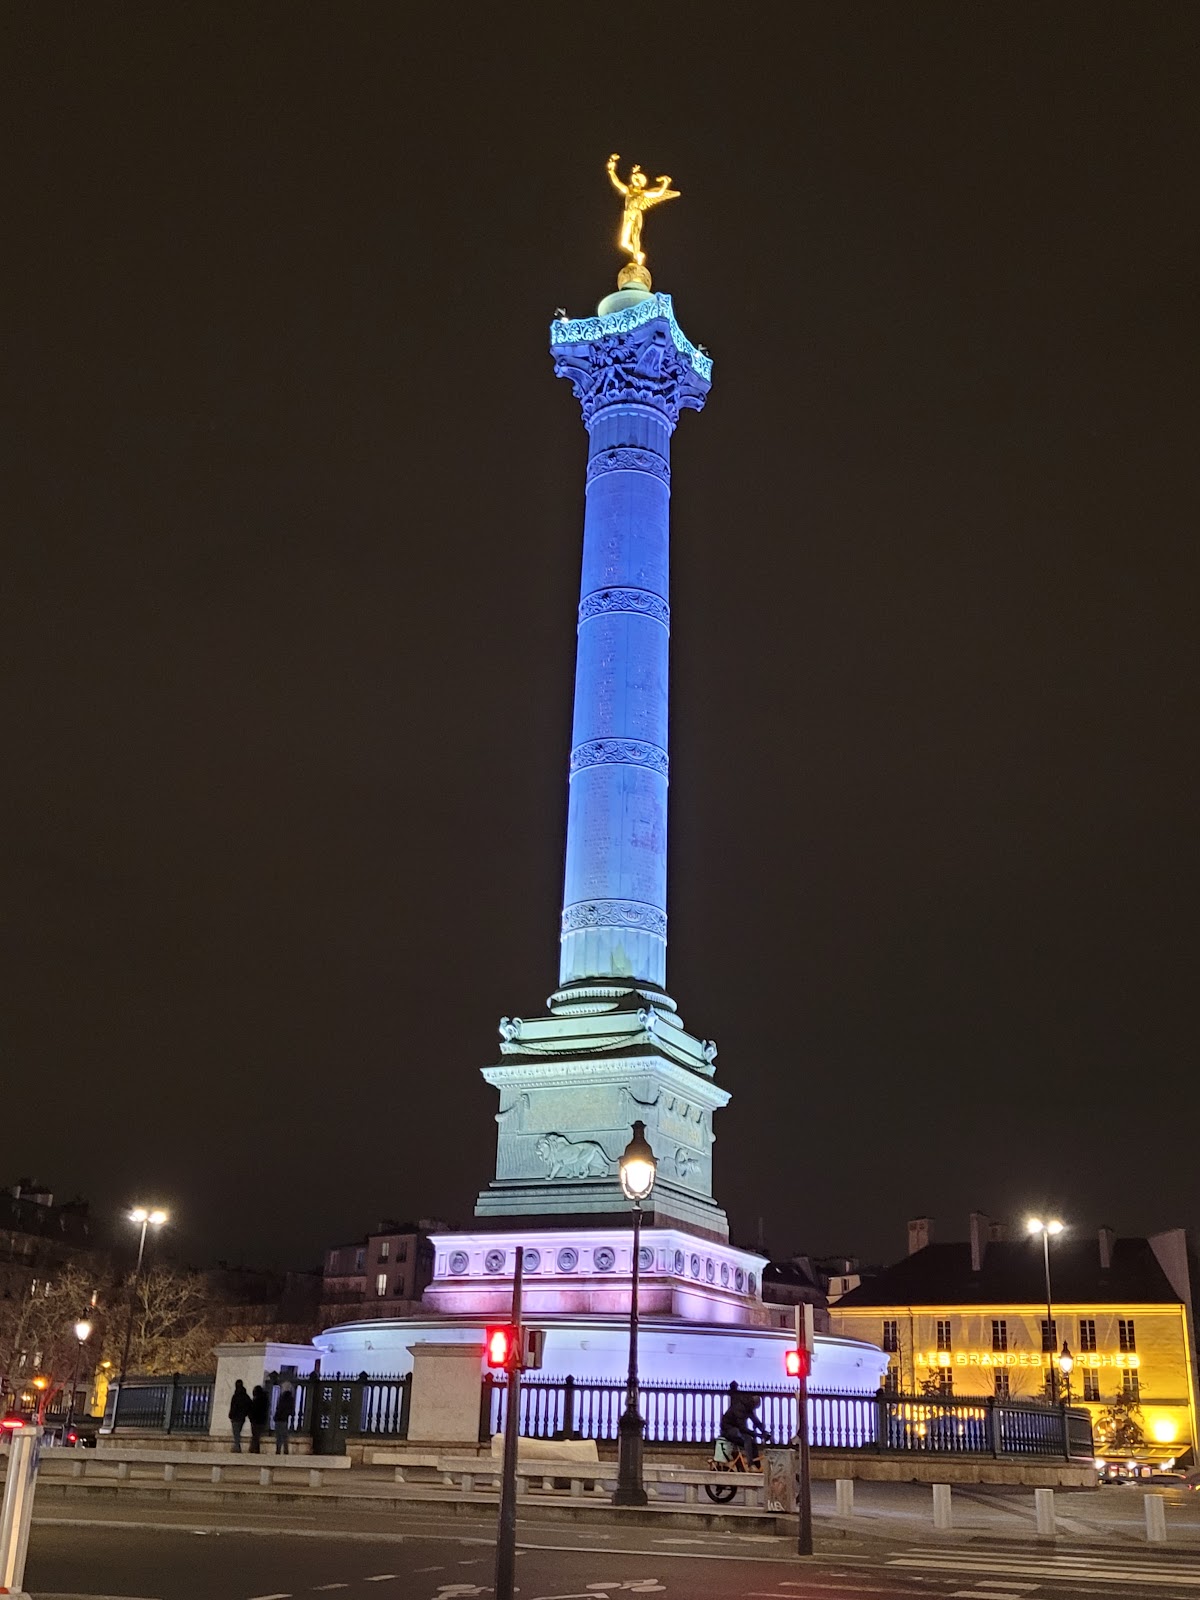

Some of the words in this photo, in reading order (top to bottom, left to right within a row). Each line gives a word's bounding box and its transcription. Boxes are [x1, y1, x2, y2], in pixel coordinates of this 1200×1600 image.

[917, 1352, 951, 1366] LES
[955, 1353, 1041, 1367] GRANDES
[1048, 1353, 1140, 1368] MRCHES
